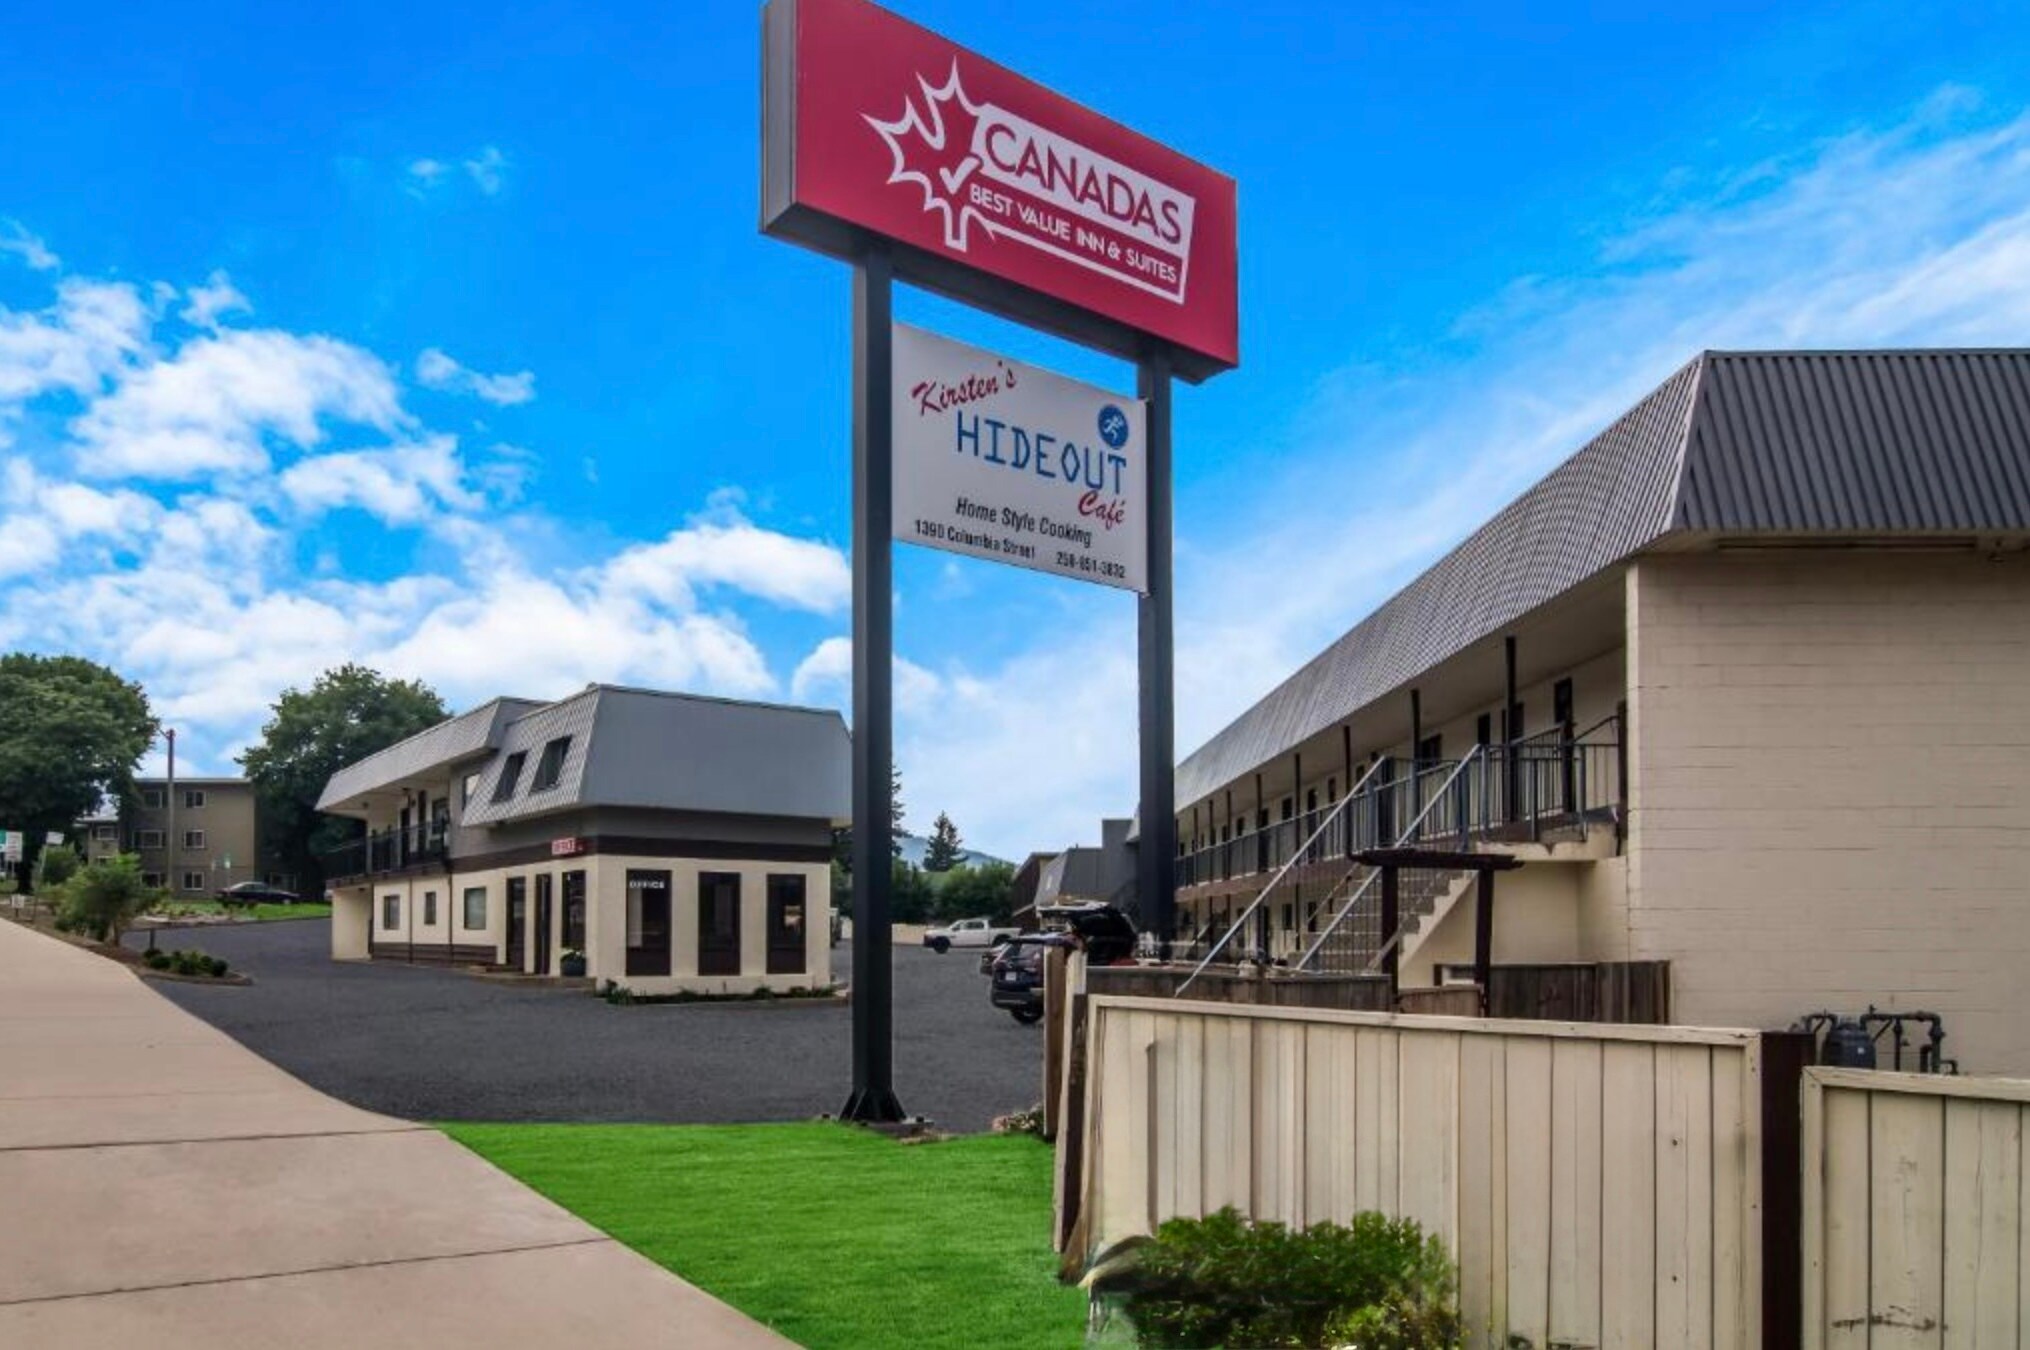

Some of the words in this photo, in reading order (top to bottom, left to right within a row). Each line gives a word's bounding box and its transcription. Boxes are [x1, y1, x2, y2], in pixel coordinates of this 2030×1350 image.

[984, 122, 1182, 245] CANADAS
[970, 183, 1013, 217] BEST
[1016, 201, 1070, 241] VALUE
[1075, 227, 1105, 254] INN
[1107, 241, 1121, 260] &
[1126, 248, 1177, 284] SUITES
[911, 360, 1017, 416] Kirsten's
[957, 410, 1127, 495] HIDEOUT
[955, 497, 997, 523] Home
[1001, 507, 1035, 533] Style
[1039, 516, 1092, 549] Cooking
[1078, 490, 1125, 531] Café
[947, 525, 1000, 551] Columbia
[1003, 538, 1035, 559] Street
